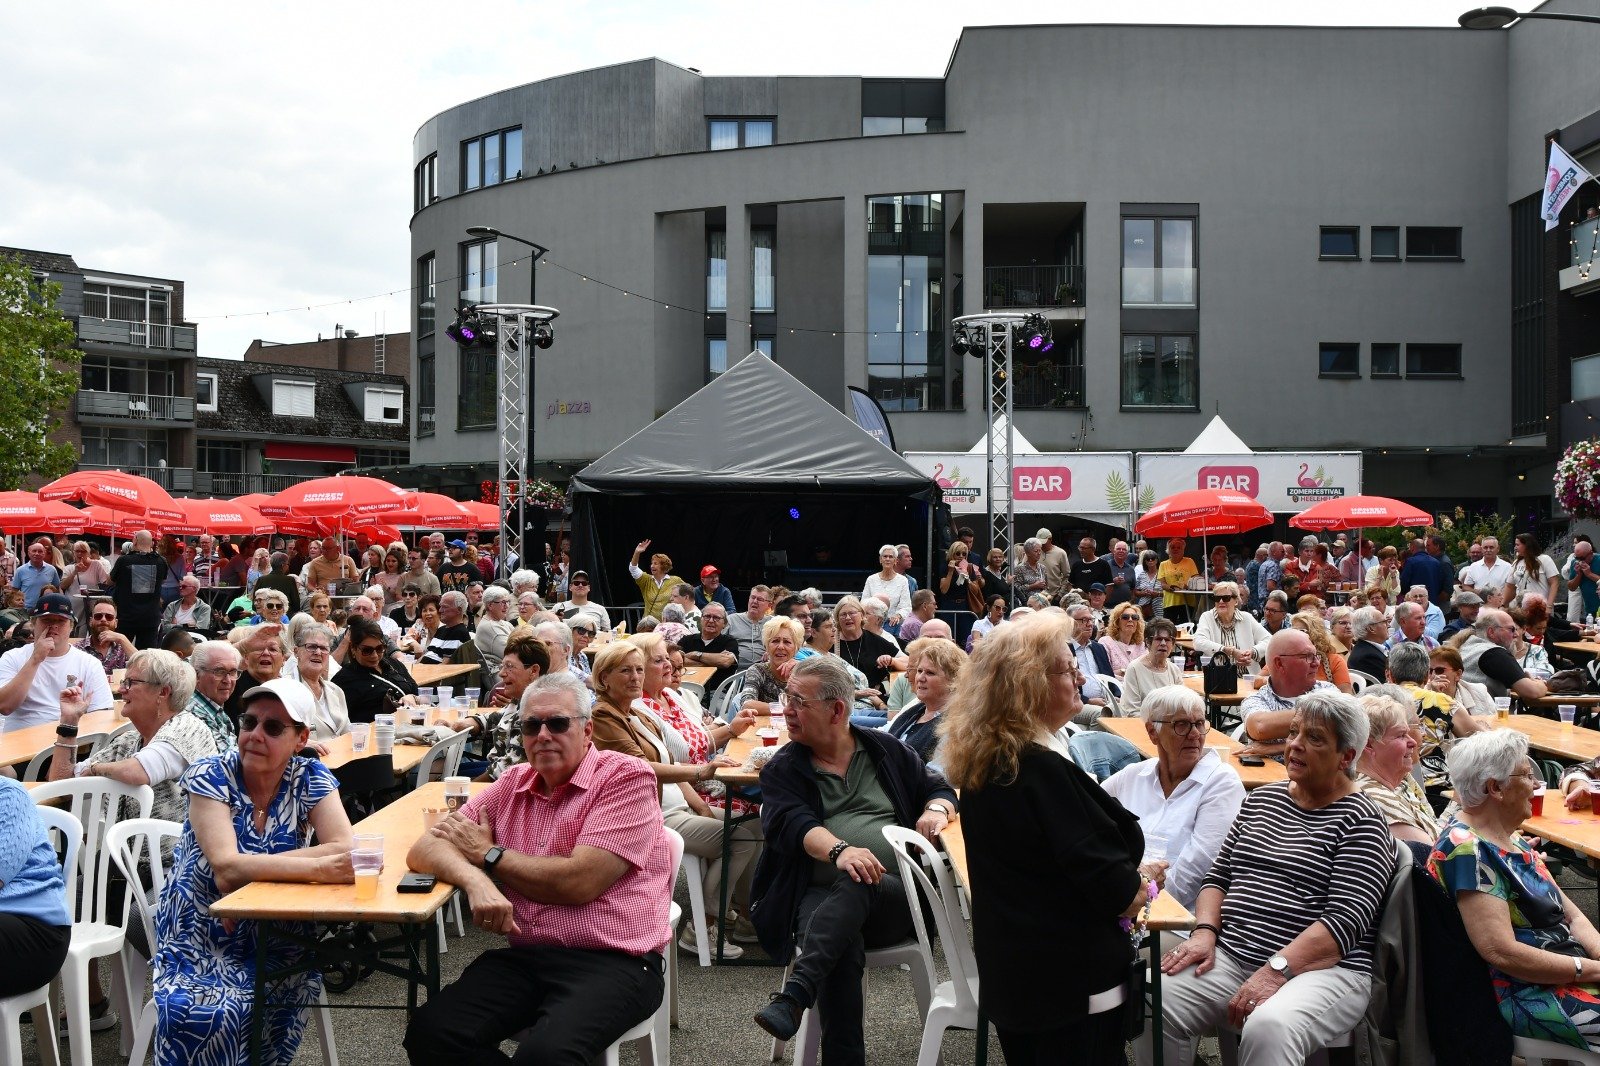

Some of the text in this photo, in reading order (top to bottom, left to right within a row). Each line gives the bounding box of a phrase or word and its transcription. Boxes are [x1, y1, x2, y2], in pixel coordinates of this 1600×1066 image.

[547, 399, 591, 420] piazza
[1018, 475, 1063, 492] BAR
[1206, 475, 1250, 492] BAR
